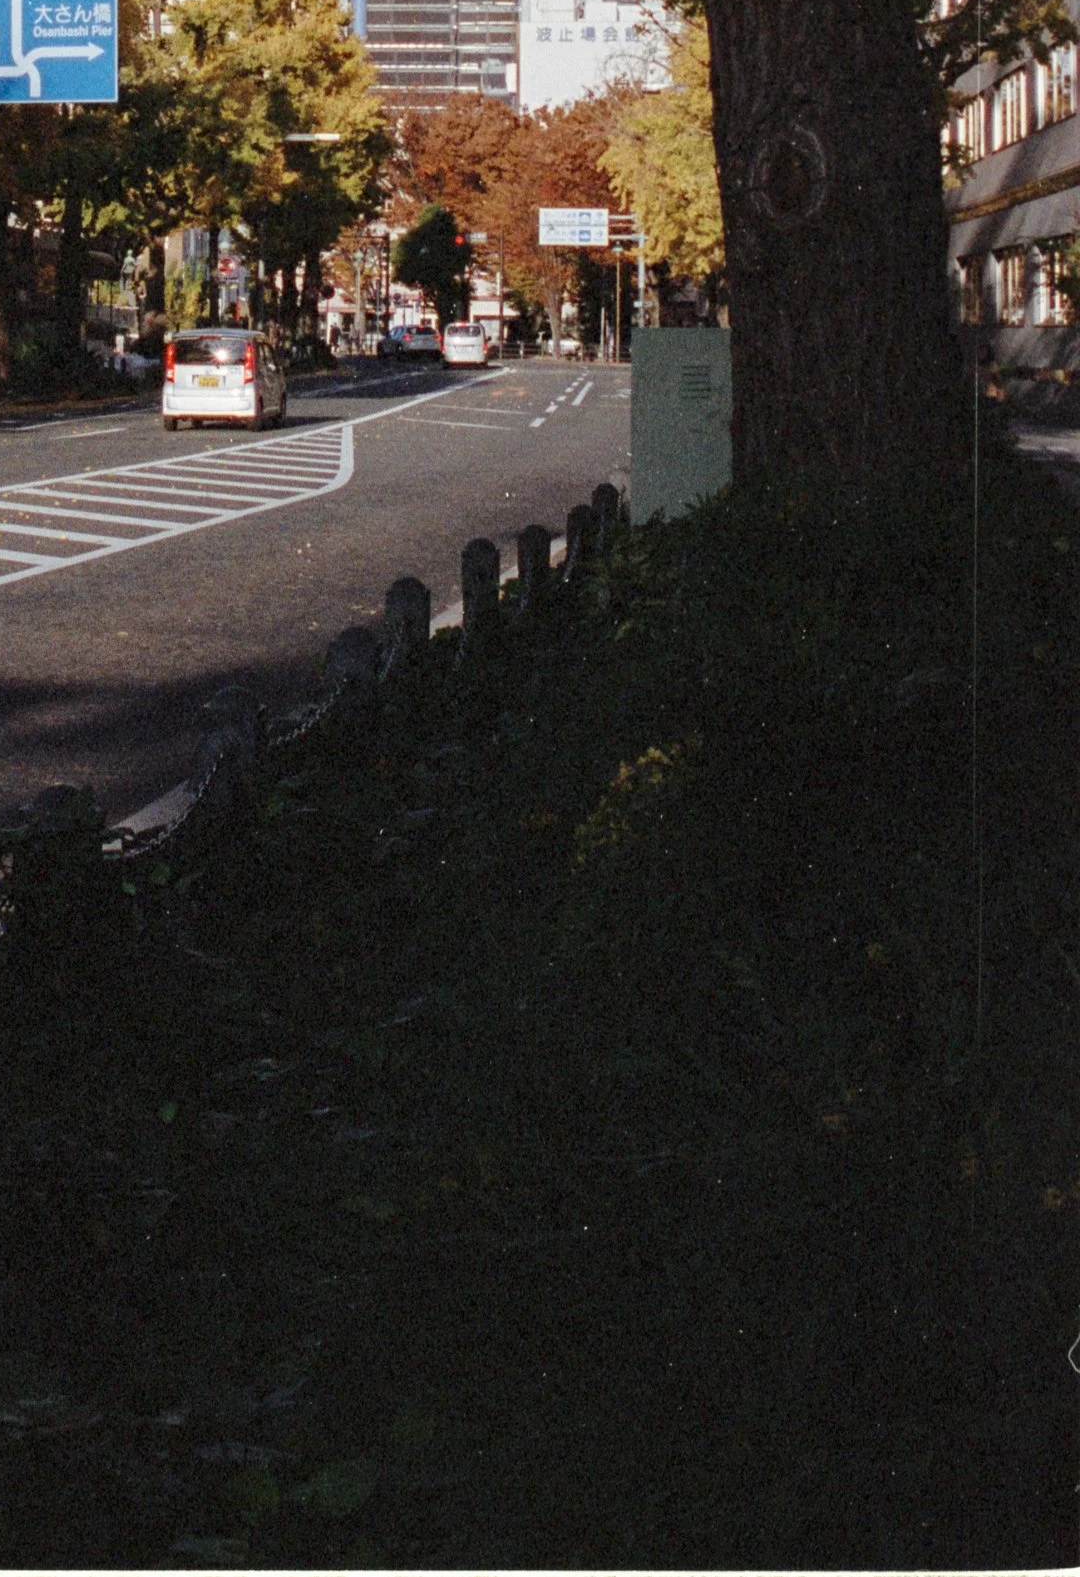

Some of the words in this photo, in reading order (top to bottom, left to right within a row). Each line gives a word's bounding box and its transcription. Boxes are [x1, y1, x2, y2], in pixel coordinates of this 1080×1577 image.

[34, 4, 112, 24] 大さん橋
[33, 26, 89, 37] Osanbashi
[91, 26, 113, 36] Pier
